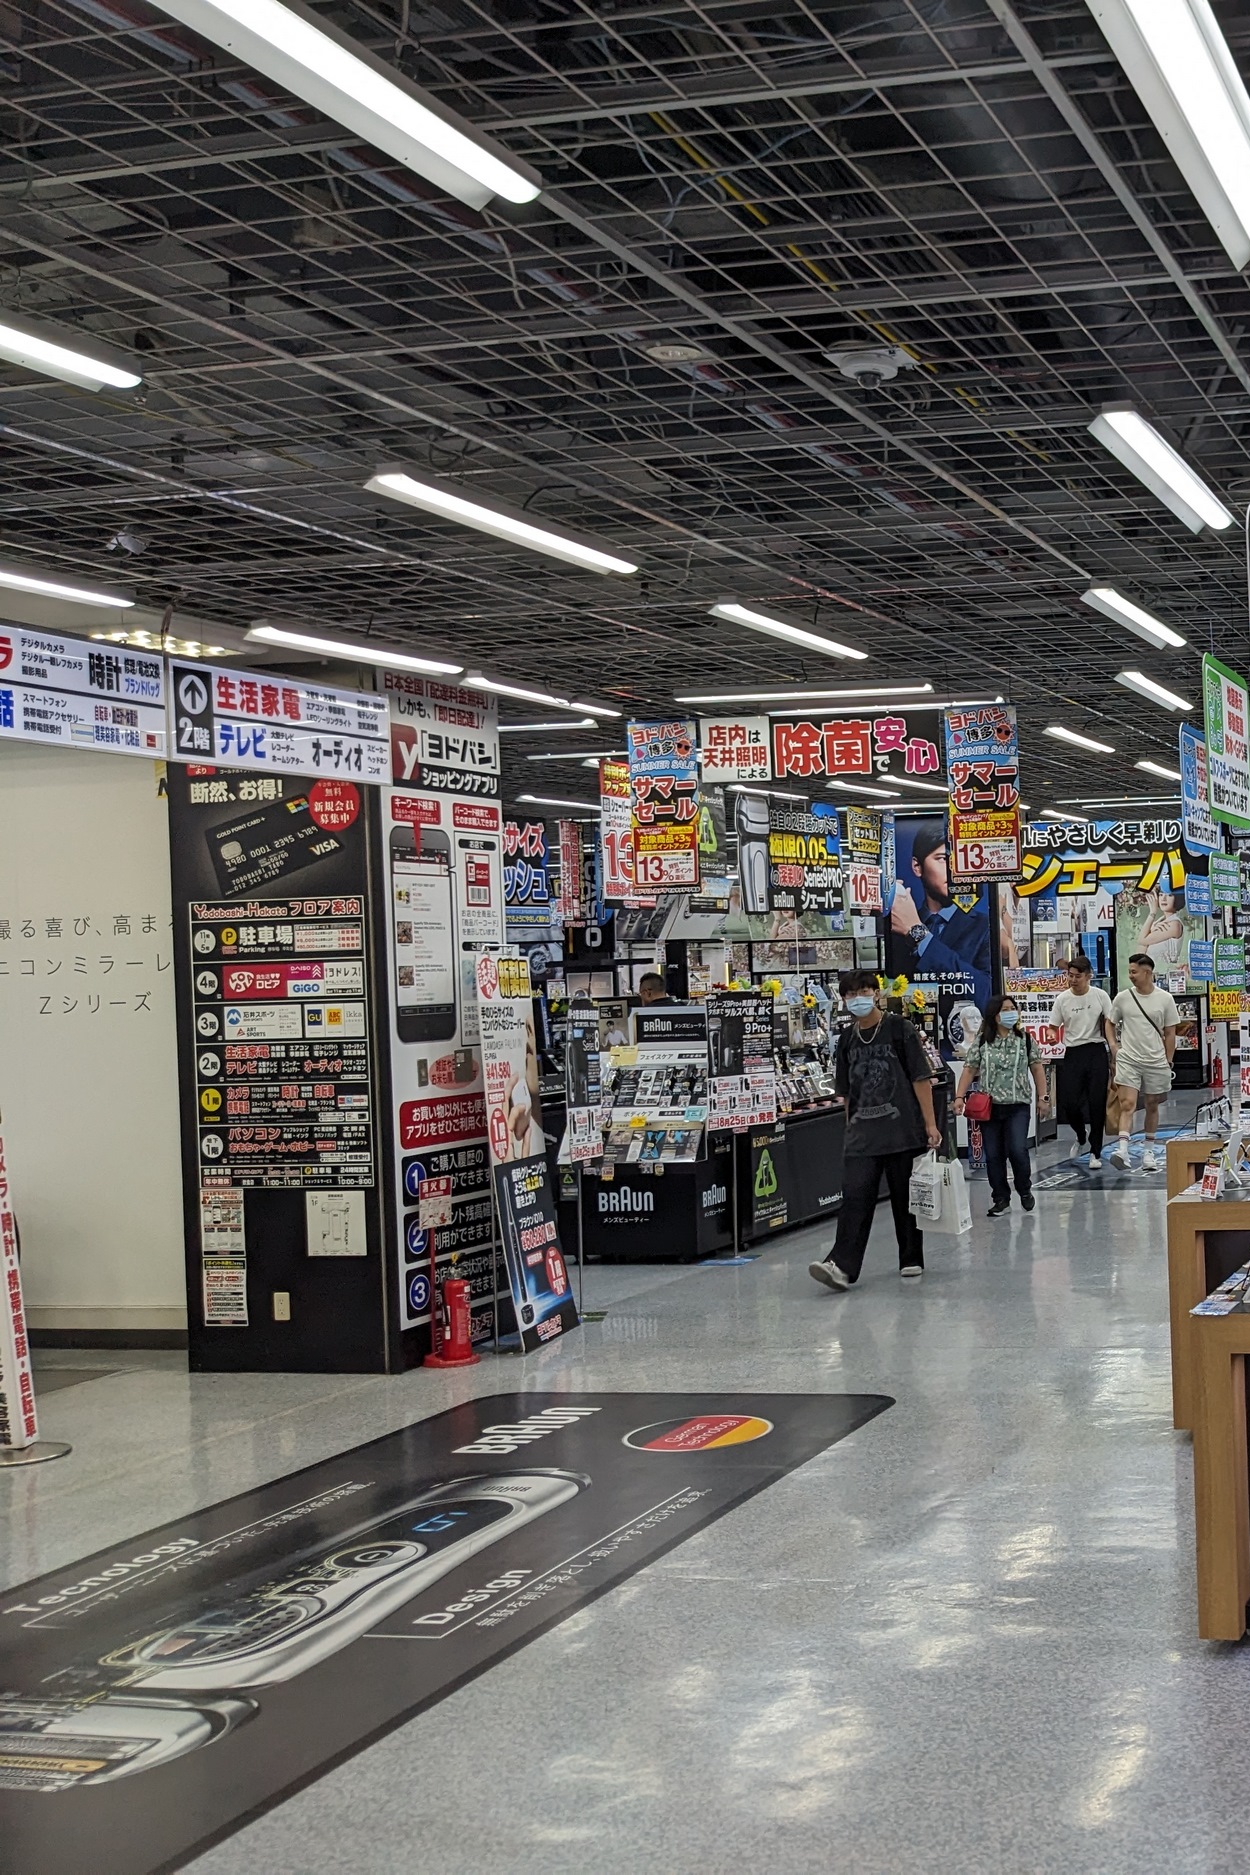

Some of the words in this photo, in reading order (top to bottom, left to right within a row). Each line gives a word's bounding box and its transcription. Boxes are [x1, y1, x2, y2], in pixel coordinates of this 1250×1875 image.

[21, 638, 65, 653] デジタルカメラ
[88, 652, 122, 692] 時計
[23, 694, 67, 708] スマートフォン
[216, 676, 301, 721] 生活家電
[23, 707, 85, 723] 携帯電話アクセサリー
[949, 708, 1007, 730] ヨドバシ
[179, 716, 210, 750] 2階
[220, 724, 267, 759] テレビ
[633, 723, 687, 745] ヨドバシ
[708, 725, 761, 746] 店内は
[312, 738, 363, 773] オーディオ
[649, 741, 674, 757] 博多
[704, 748, 768, 768] 天井照明
[949, 747, 989, 758] SUMMER
[991, 745, 1016, 755] SALE
[632, 760, 669, 773] SUMMER
[672, 760, 695, 770] SALE
[737, 769, 768, 779] による
[951, 761, 1017, 784] サマー
[422, 768, 498, 795] ショッピングアプリ
[633, 775, 696, 800] サマー
[952, 784, 1019, 809] セール
[634, 800, 698, 823] セール
[310, 839, 339, 855] VISA
[801, 887, 841, 909] シェーバー
[239, 926, 293, 945] 駐車場
[293, 984, 319, 992] GiGO
[40, 991, 151, 1014] Zシリーズ
[644, 1018, 672, 1032] BRAUN
[226, 1061, 257, 1074] テレビ
[227, 1087, 249, 1099] カメラ
[229, 1127, 281, 1140] パソコン
[599, 1186, 654, 1212] BRAUN
[703, 1184, 727, 1208] BRAUN
[452, 1407, 602, 1454] BRAUN
[413, 1568, 532, 1625] Design
